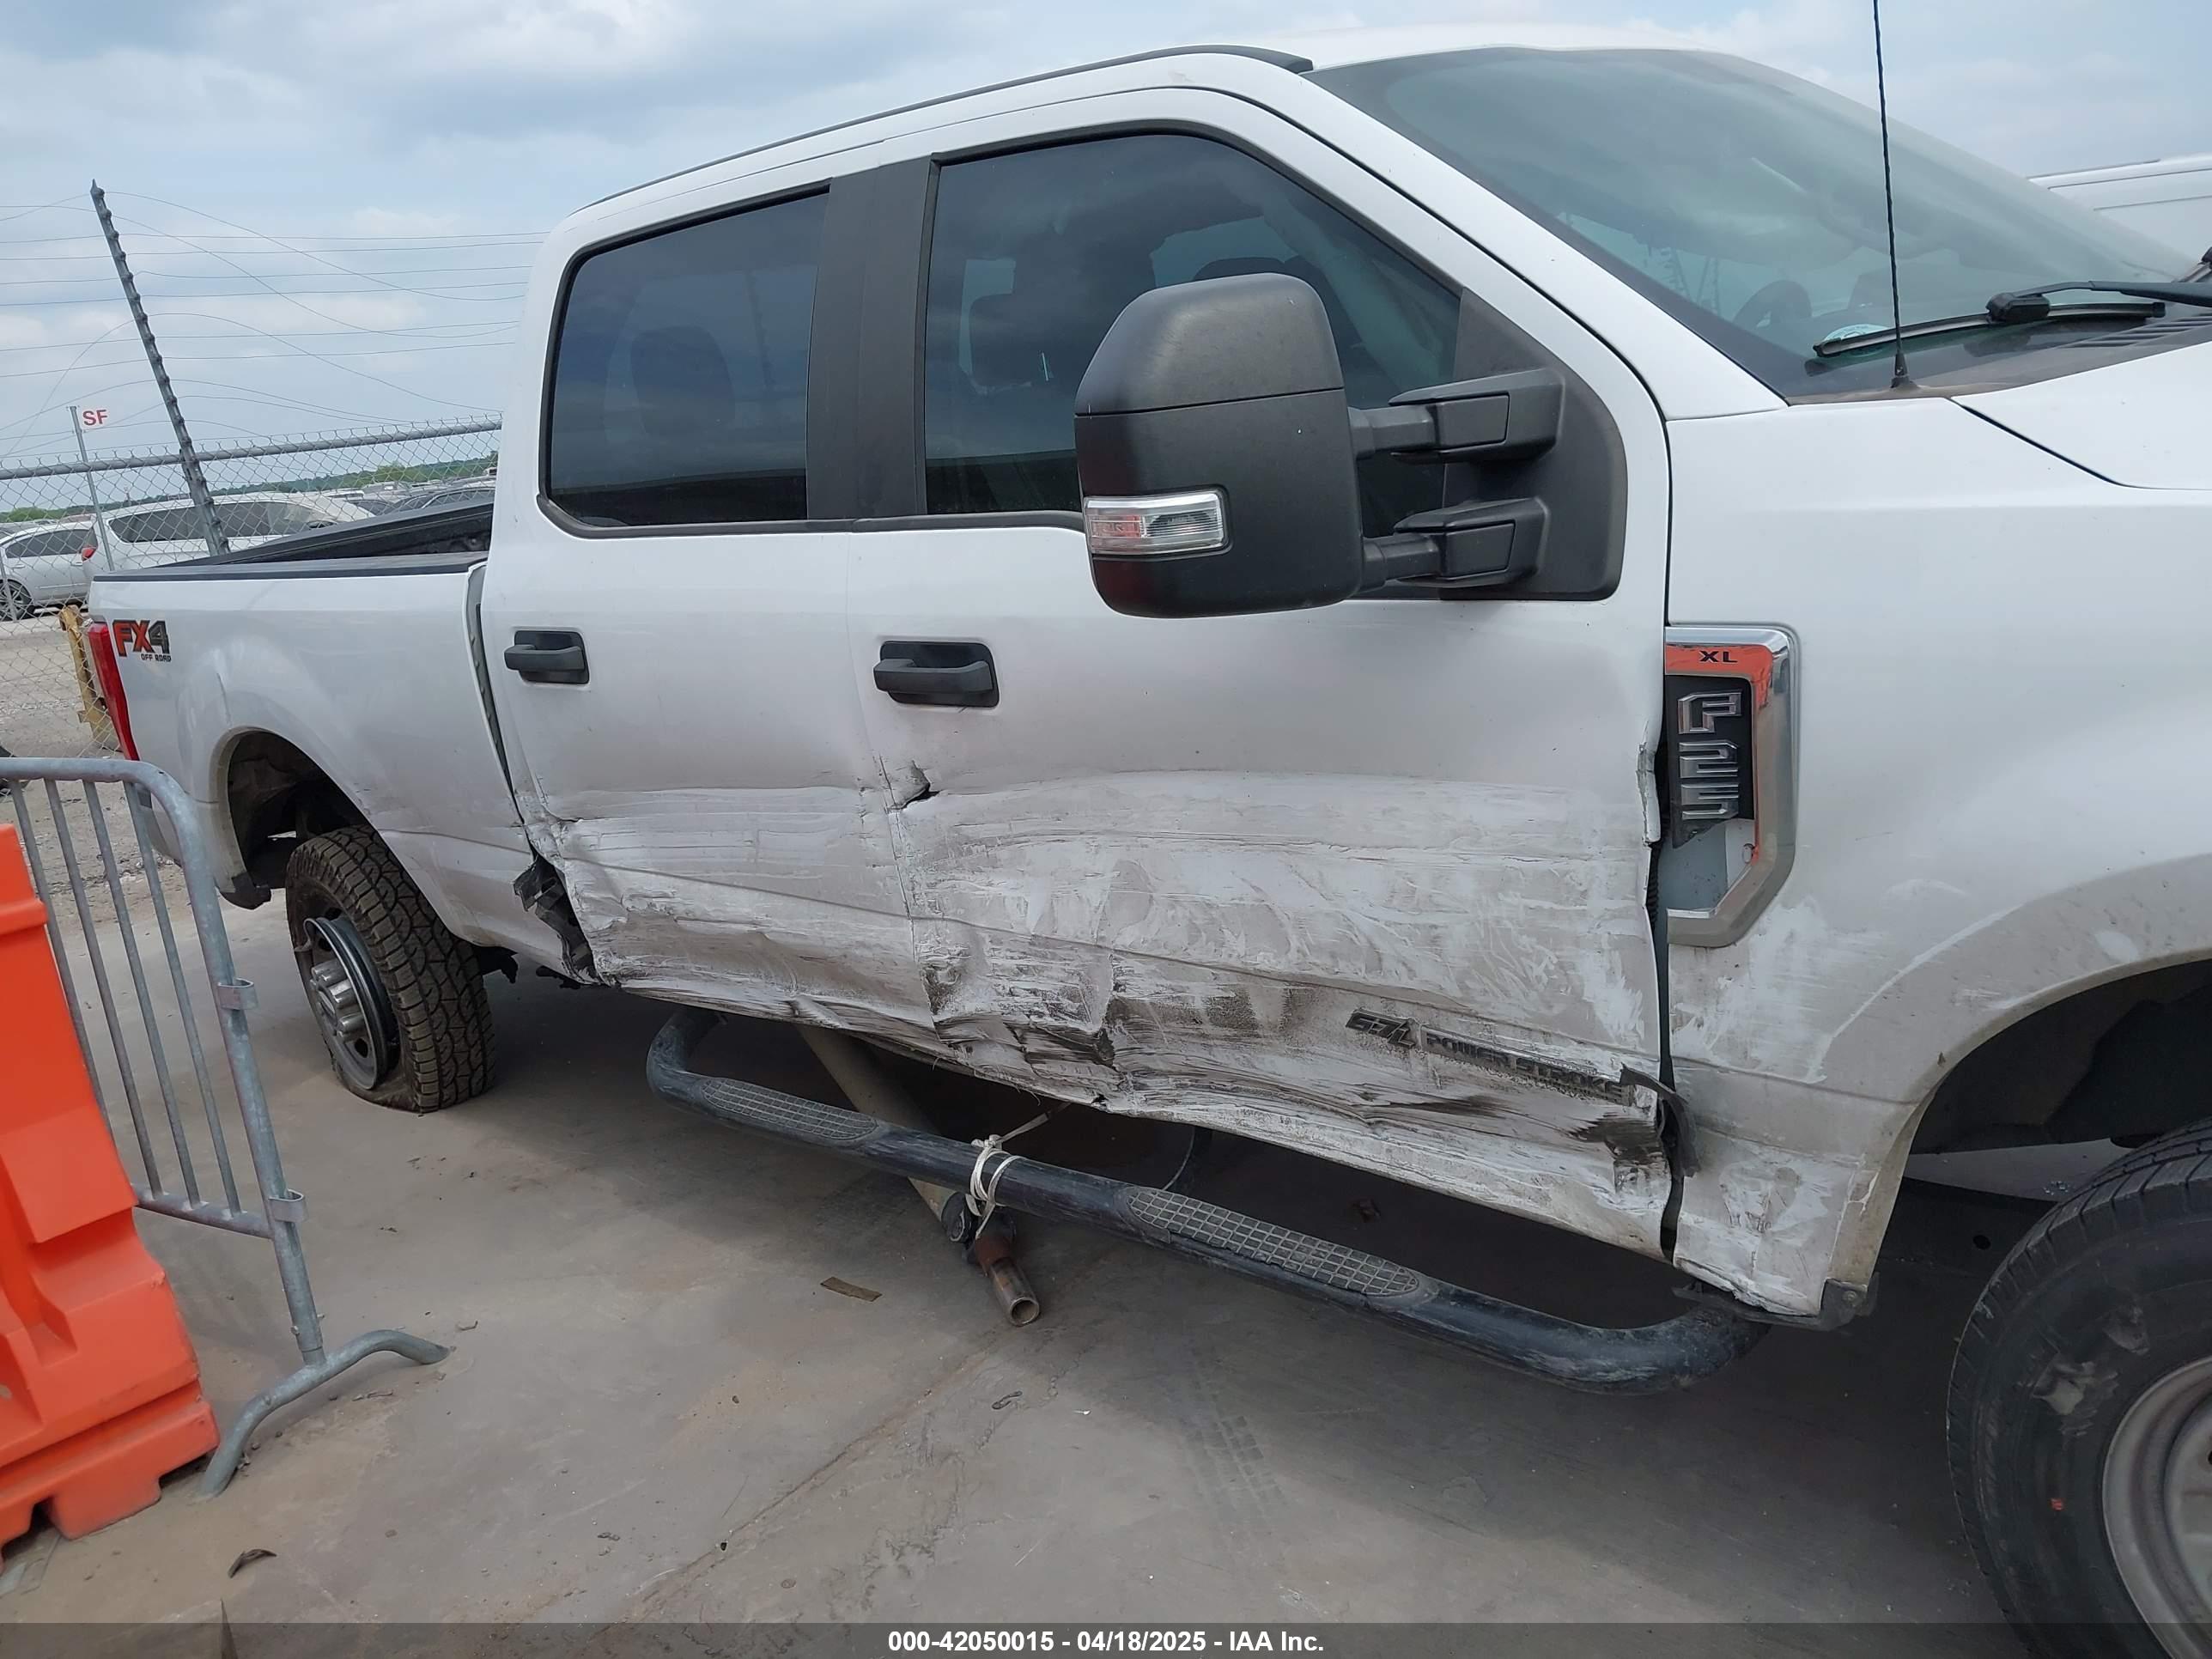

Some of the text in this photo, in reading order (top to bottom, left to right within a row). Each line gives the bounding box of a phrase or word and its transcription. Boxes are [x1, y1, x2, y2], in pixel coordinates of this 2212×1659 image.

[82, 409, 108, 426] SF
[112, 620, 170, 658] FX4
[155, 653, 172, 663] ROAD
[1698, 650, 1738, 663] XL
